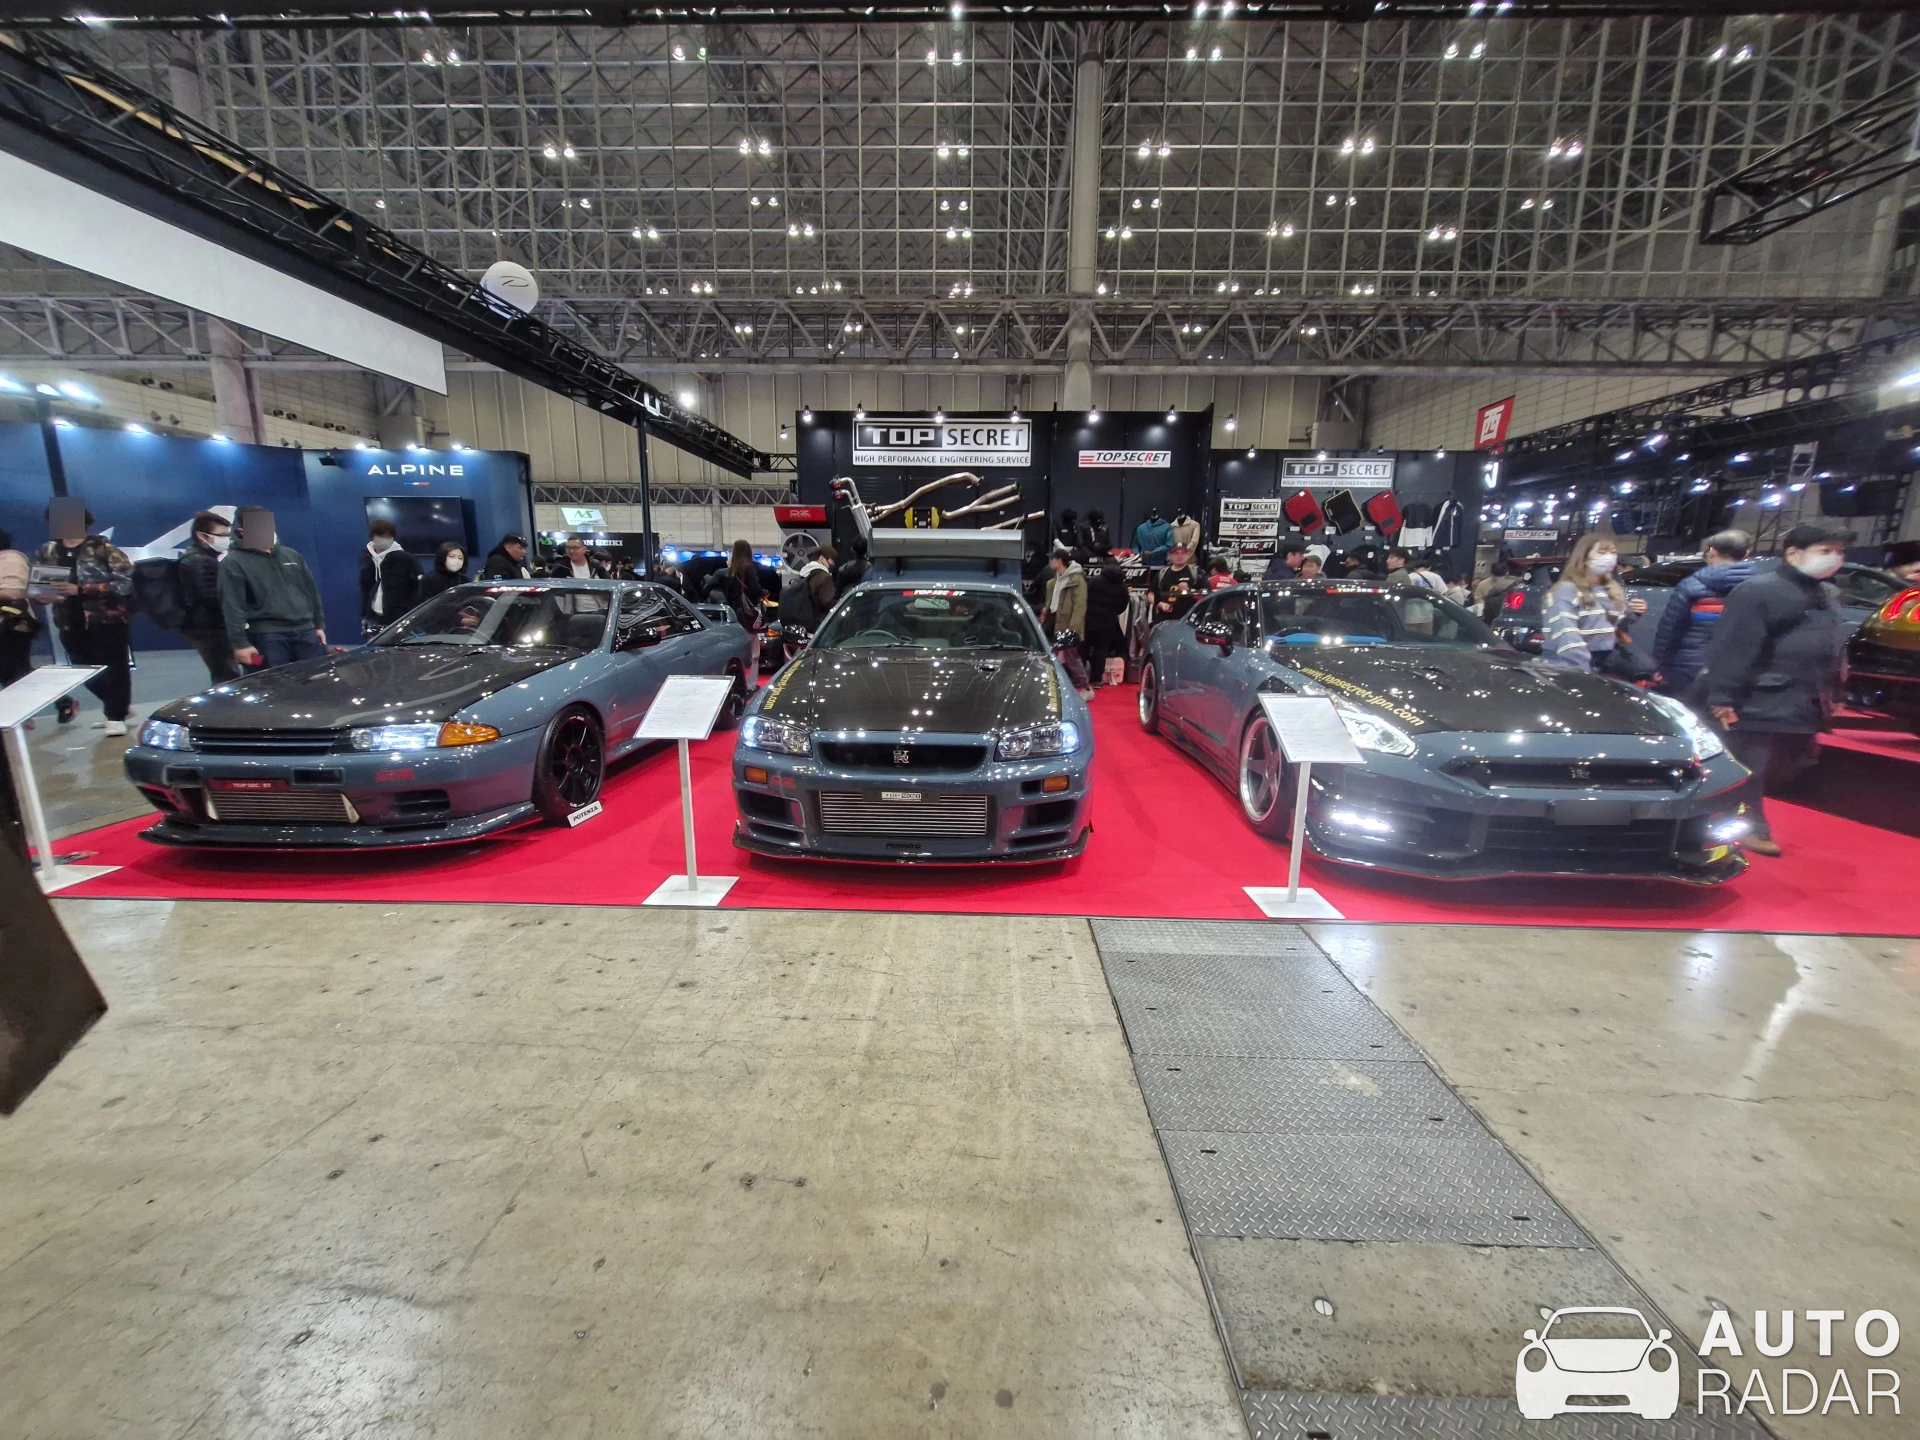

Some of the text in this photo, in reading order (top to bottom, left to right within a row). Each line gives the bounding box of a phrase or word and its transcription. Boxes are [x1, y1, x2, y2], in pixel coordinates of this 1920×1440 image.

[1480, 404, 1505, 443] 西
[865, 428, 1024, 446] TOP SECRET
[855, 455, 1030, 464] HIGH PERFORMANCE ENGINEERING SERVICE
[1096, 452, 1169, 462] TOP SECRET
[367, 464, 464, 476] ALPINE
[1290, 464, 1389, 475] TOP SECRET
[595, 539, 624, 547] SEIKI
[1301, 666, 1425, 727] www.topsecret-jpn.com
[572, 805, 599, 822] POTENZA
